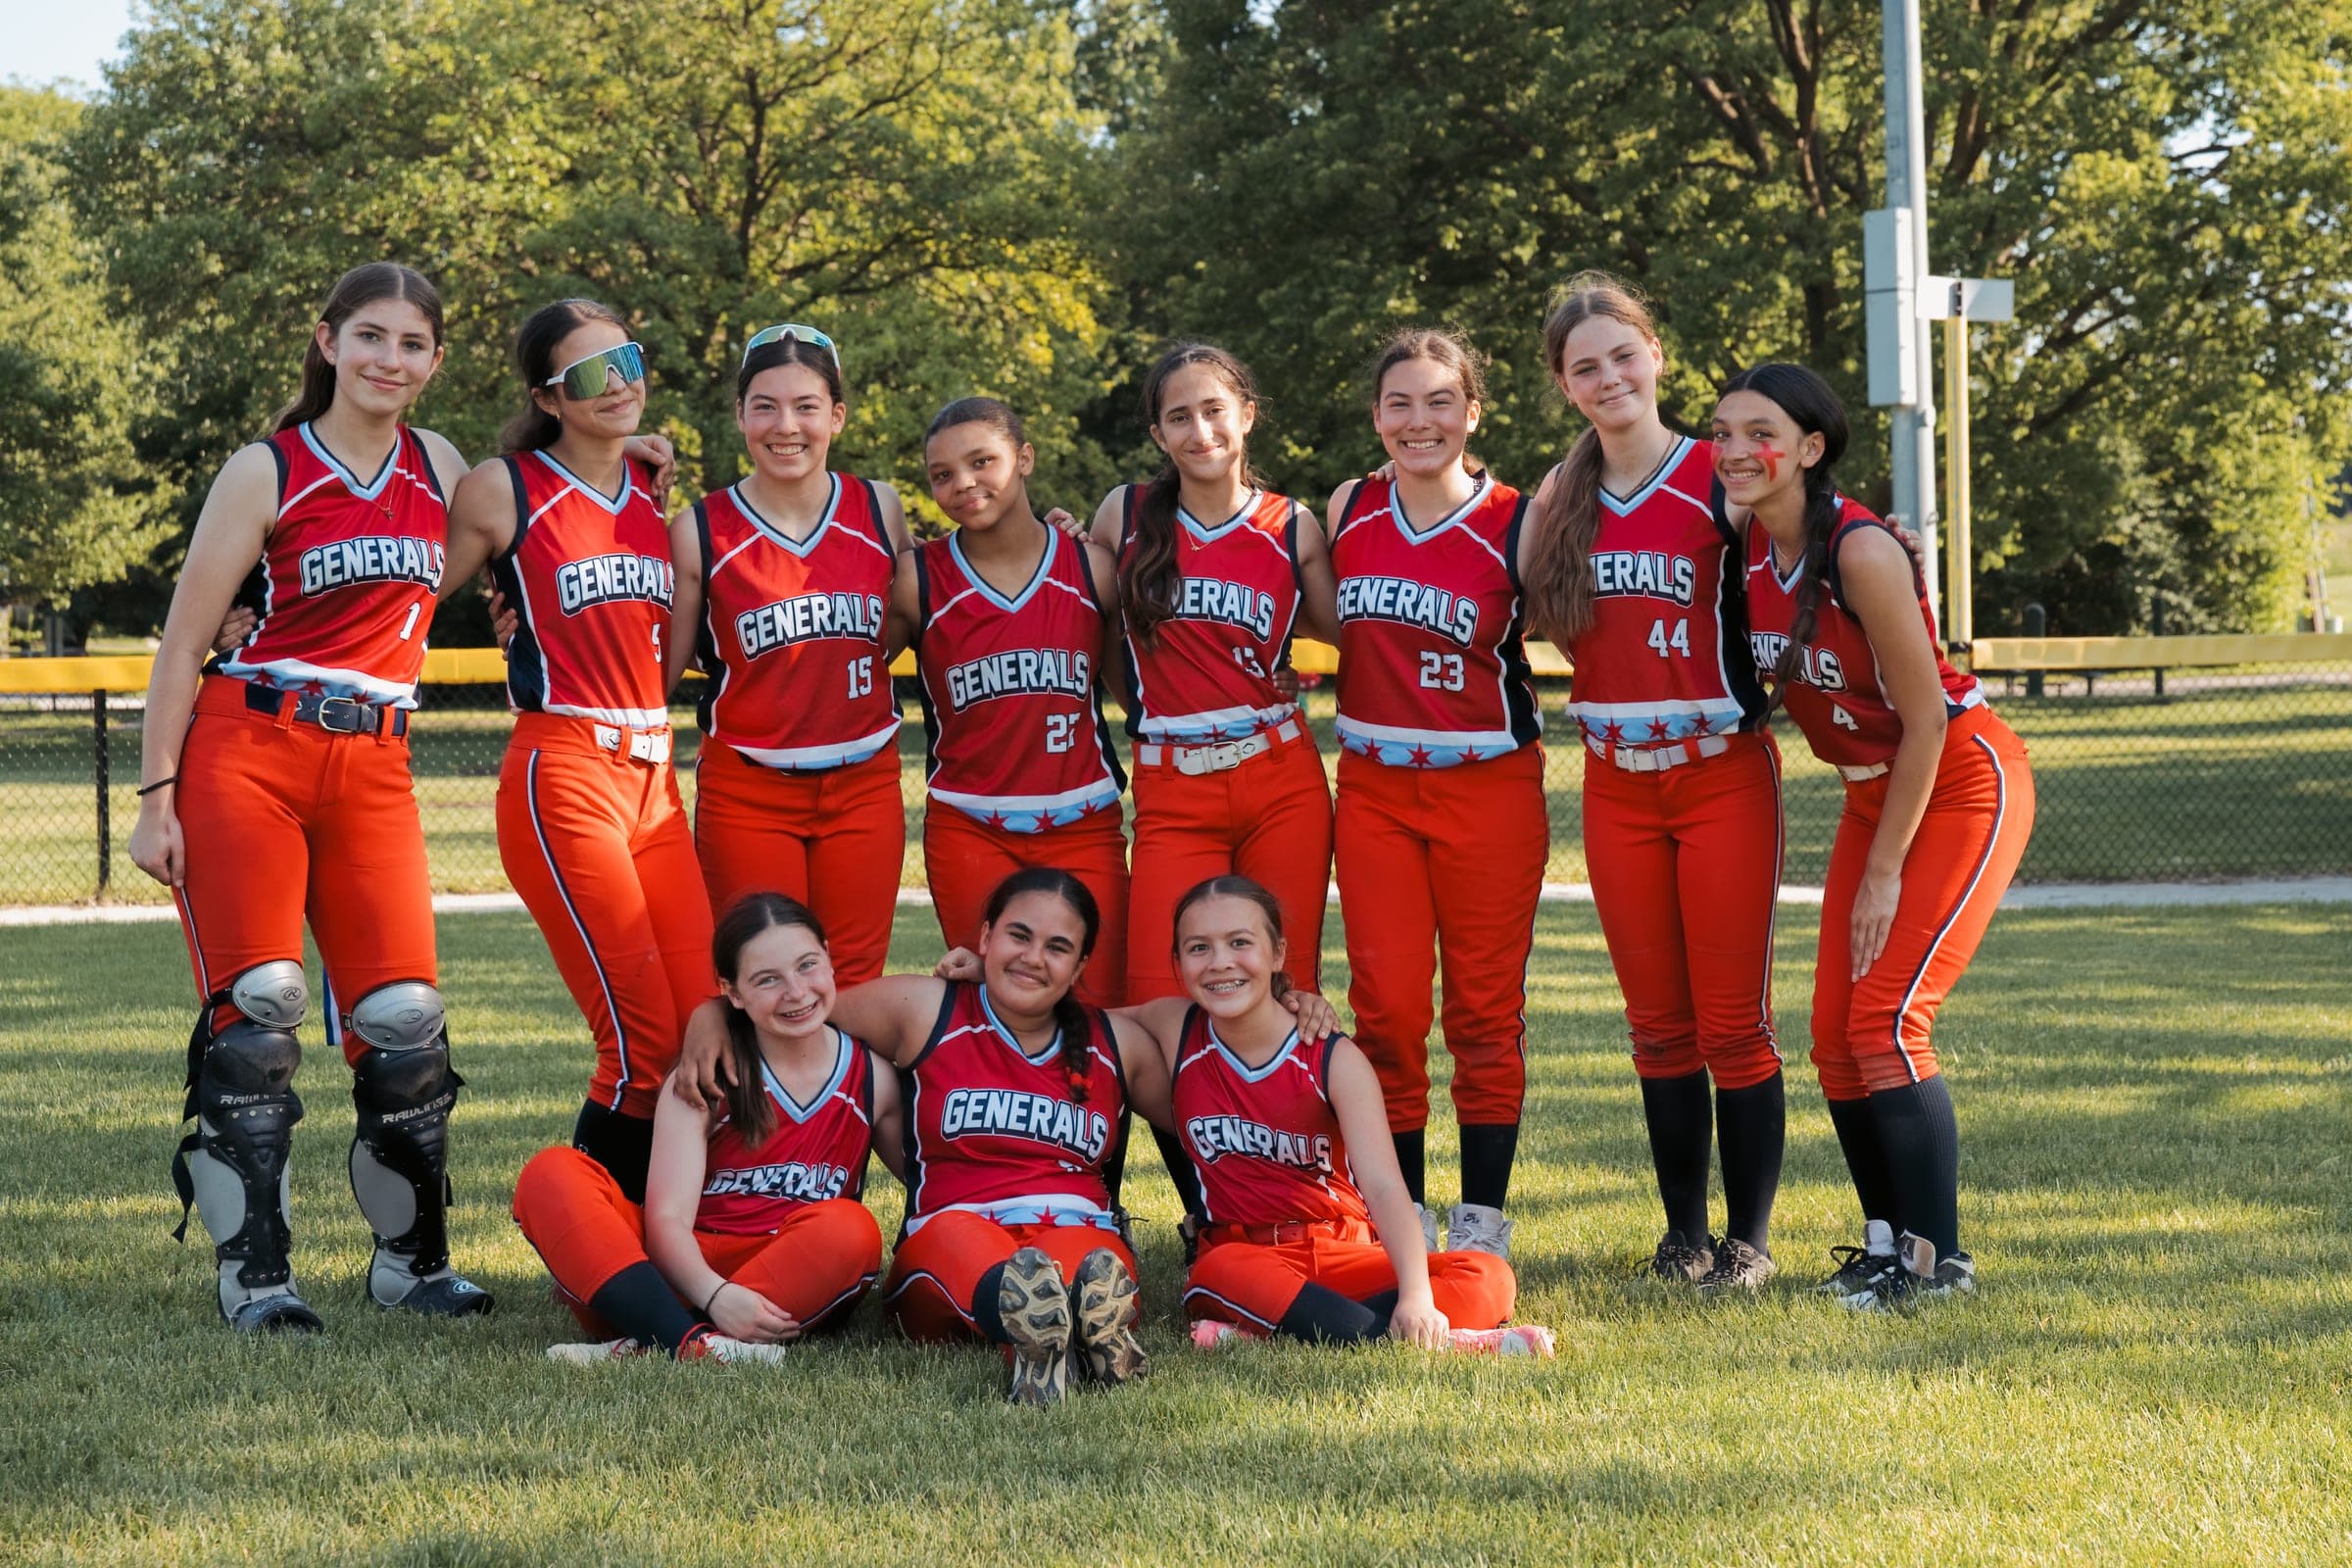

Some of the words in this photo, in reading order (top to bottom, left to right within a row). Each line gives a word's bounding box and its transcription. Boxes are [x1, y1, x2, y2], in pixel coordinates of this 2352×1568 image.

[300, 536, 445, 597] GENERALS
[1589, 550, 1695, 609] ERALS
[399, 602, 421, 640] 1
[737, 592, 882, 662] GENERALS
[1172, 576, 1275, 644] ERALS
[1337, 574, 1479, 650] GENERALS
[1647, 617, 1691, 659] 44
[847, 656, 873, 700] 15
[946, 648, 1090, 713] GENERALS
[1420, 650, 1465, 692] 23
[941, 1088, 1109, 1165] GENERALS
[1186, 1114, 1335, 1176] GENERALS
